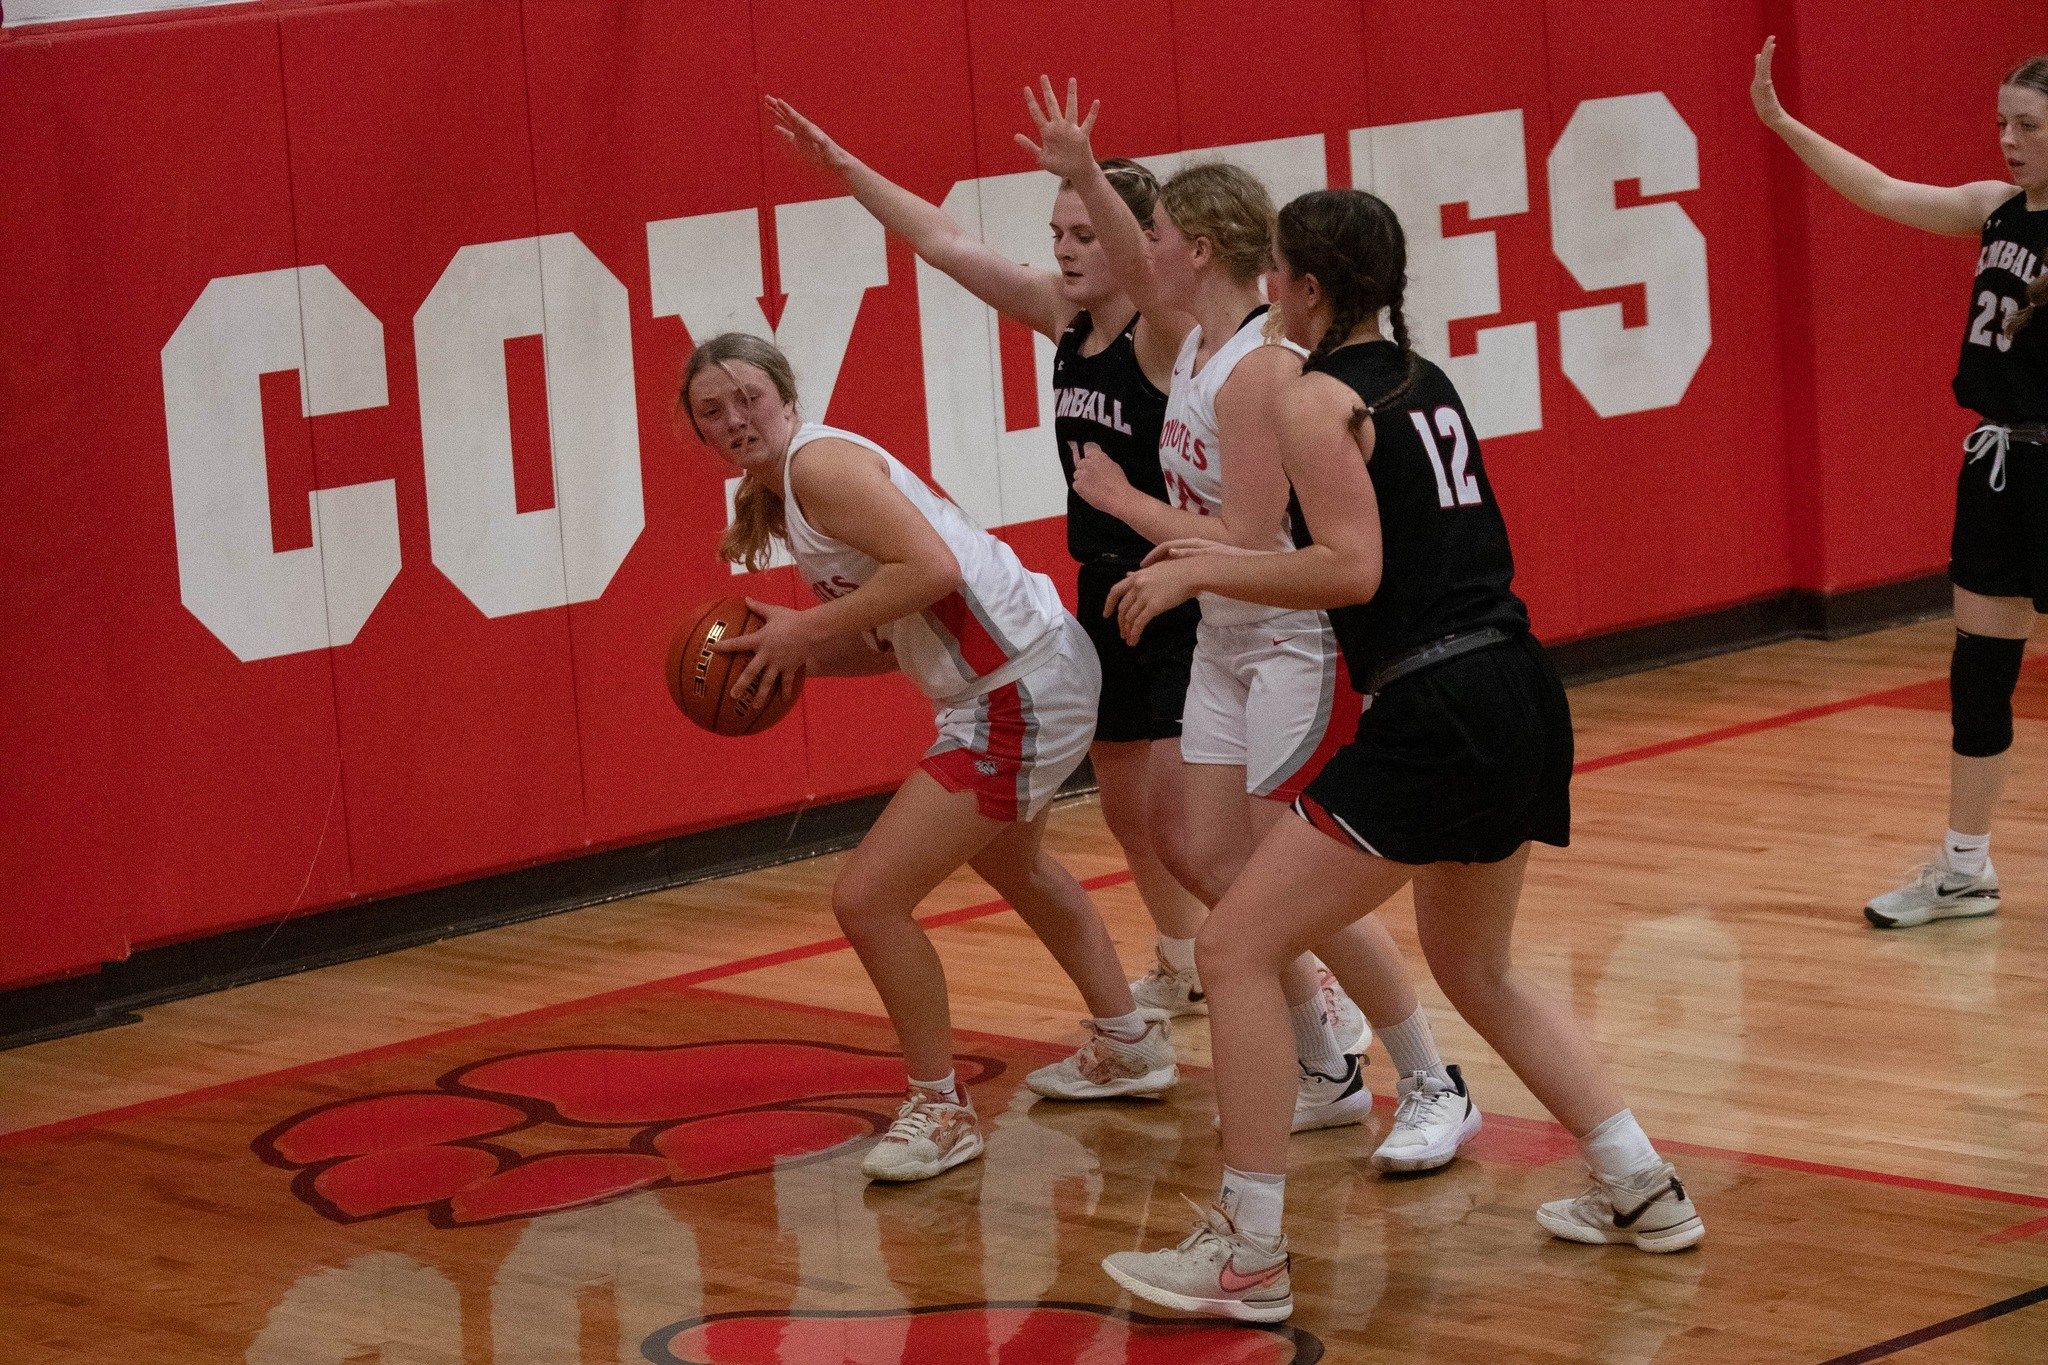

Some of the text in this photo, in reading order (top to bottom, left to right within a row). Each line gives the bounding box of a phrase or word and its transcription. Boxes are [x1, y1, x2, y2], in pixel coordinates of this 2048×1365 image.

[1969, 291, 2018, 352] 23
[1159, 418, 1208, 471] OYOTES
[1410, 405, 1482, 508] 12
[692, 619, 728, 697] ELITE
